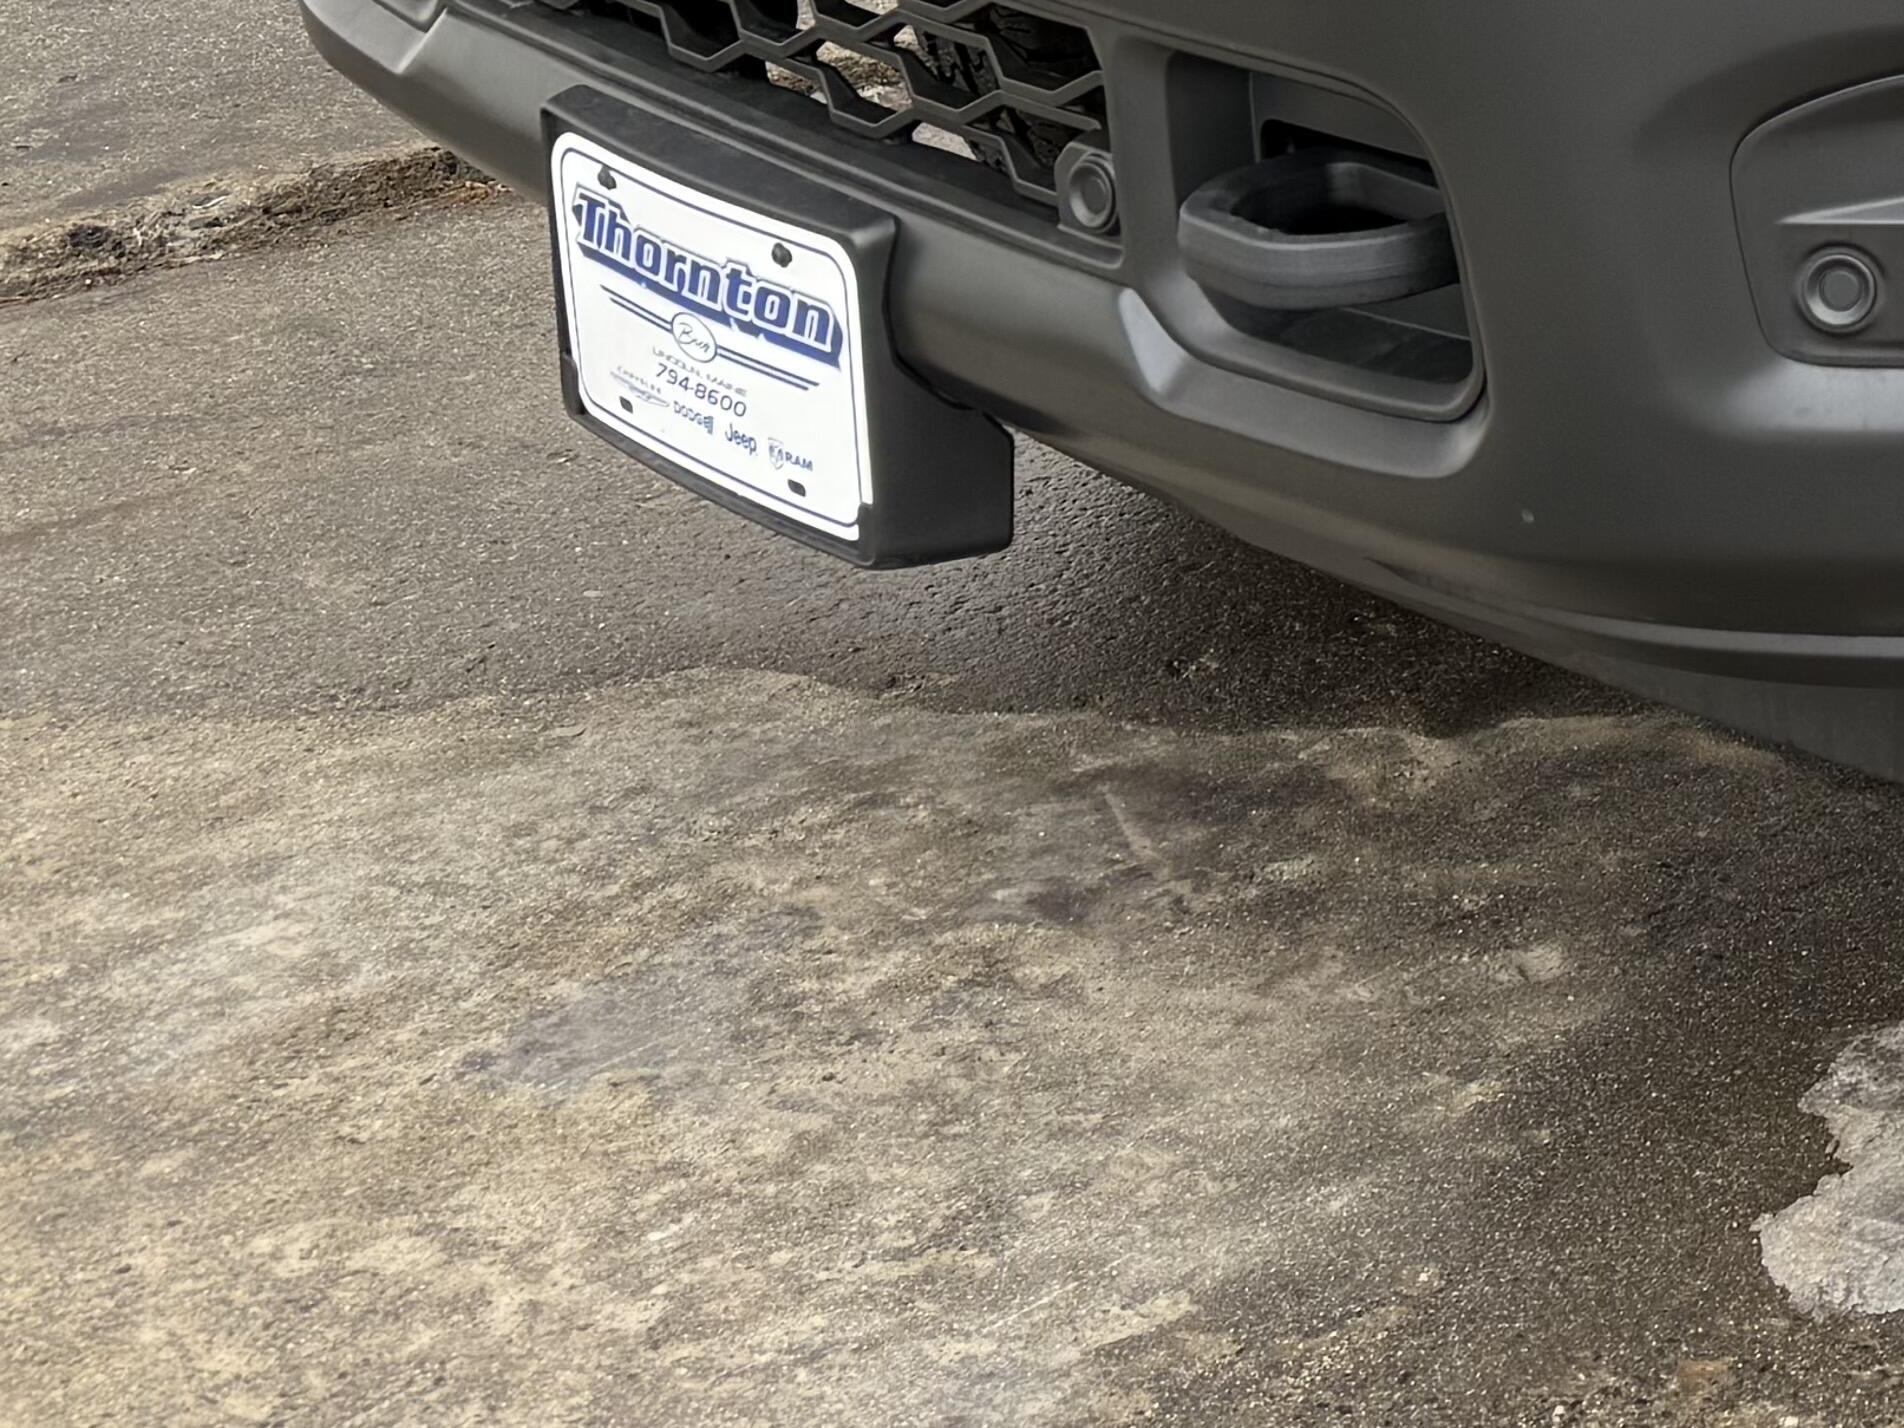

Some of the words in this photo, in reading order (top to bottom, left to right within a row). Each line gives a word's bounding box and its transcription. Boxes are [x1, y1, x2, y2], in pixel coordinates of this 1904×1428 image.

[572, 184, 843, 369] Thornton
[655, 361, 748, 418] 794-8600
[724, 422, 758, 456] Jeep
